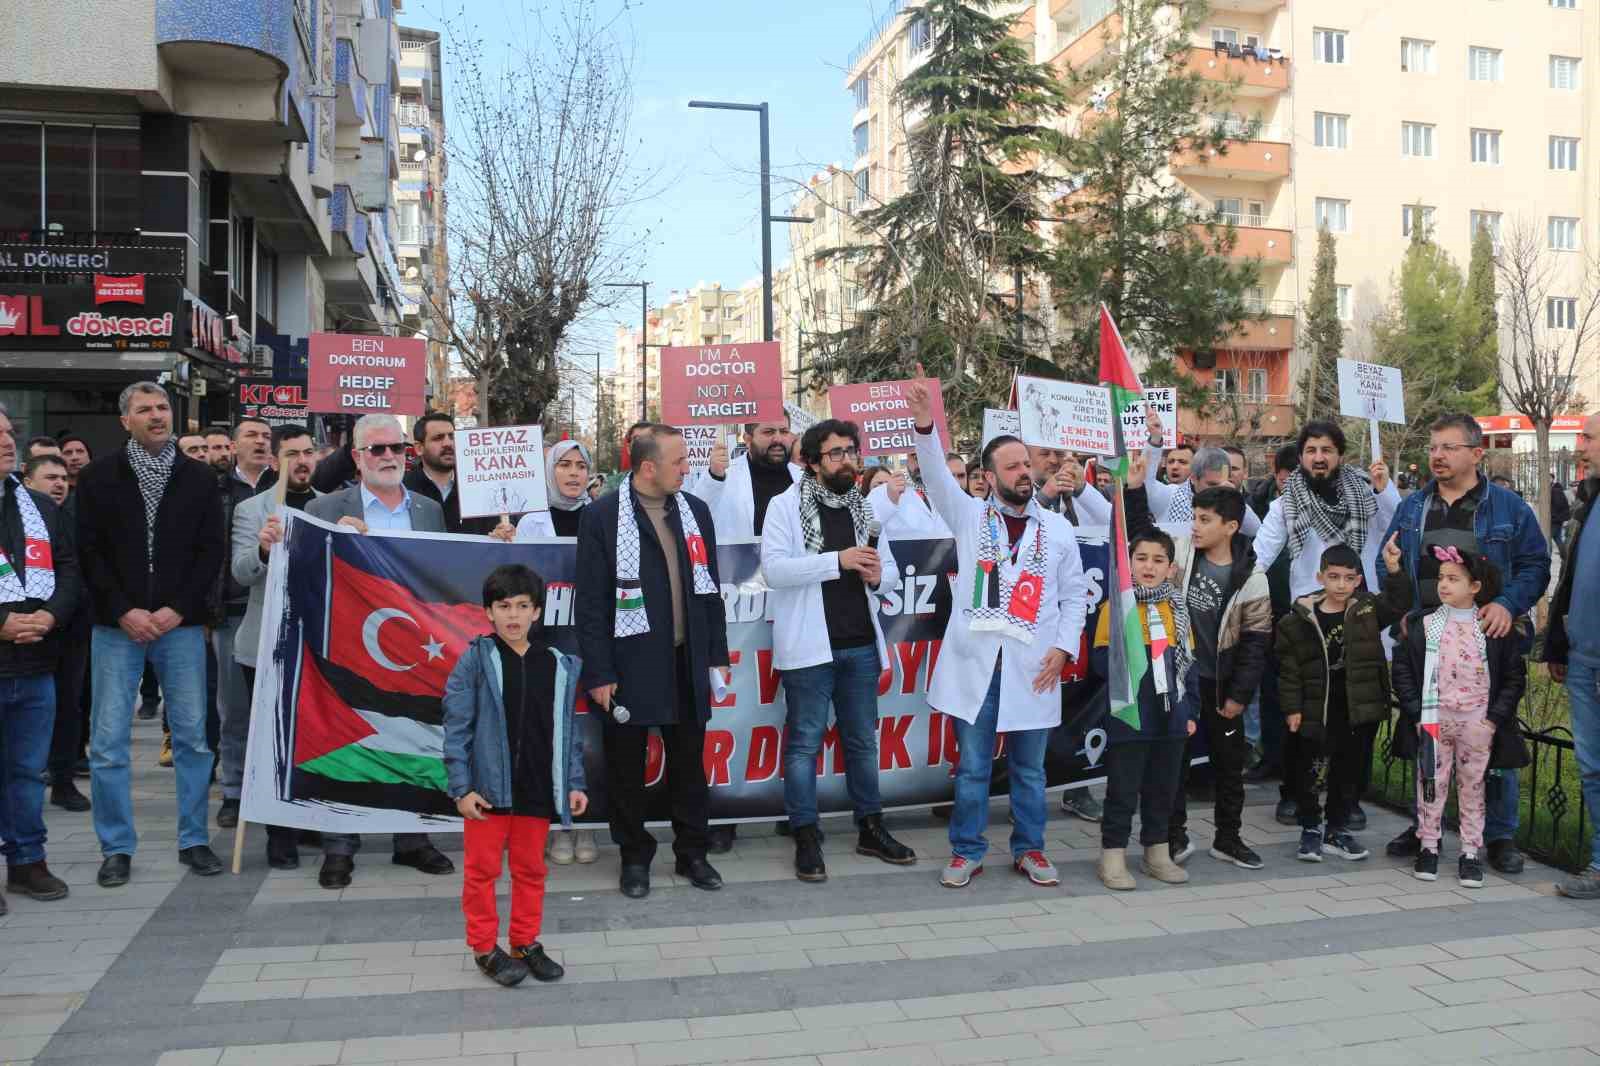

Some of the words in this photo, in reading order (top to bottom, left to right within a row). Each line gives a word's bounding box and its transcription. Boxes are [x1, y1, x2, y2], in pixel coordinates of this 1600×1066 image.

[23, 250, 109, 269] DÖNERCİ
[352, 338, 384, 353] BEN
[329, 354, 406, 368] DOKTORUM
[699, 349, 720, 361] I'M
[729, 348, 741, 360] A
[685, 361, 756, 377] DOCTOR
[339, 375, 395, 390] HEDEF
[697, 384, 729, 398] NOT
[734, 384, 745, 396] A
[869, 385, 902, 399] BEN
[342, 391, 392, 408] DEĞİL
[687, 402, 758, 417] TARGET!
[468, 429, 528, 447] BEYAZ
[474, 453, 527, 472] KANA
[467, 470, 535, 483] BULANMASIN
[880, 565, 938, 616] SİZ
